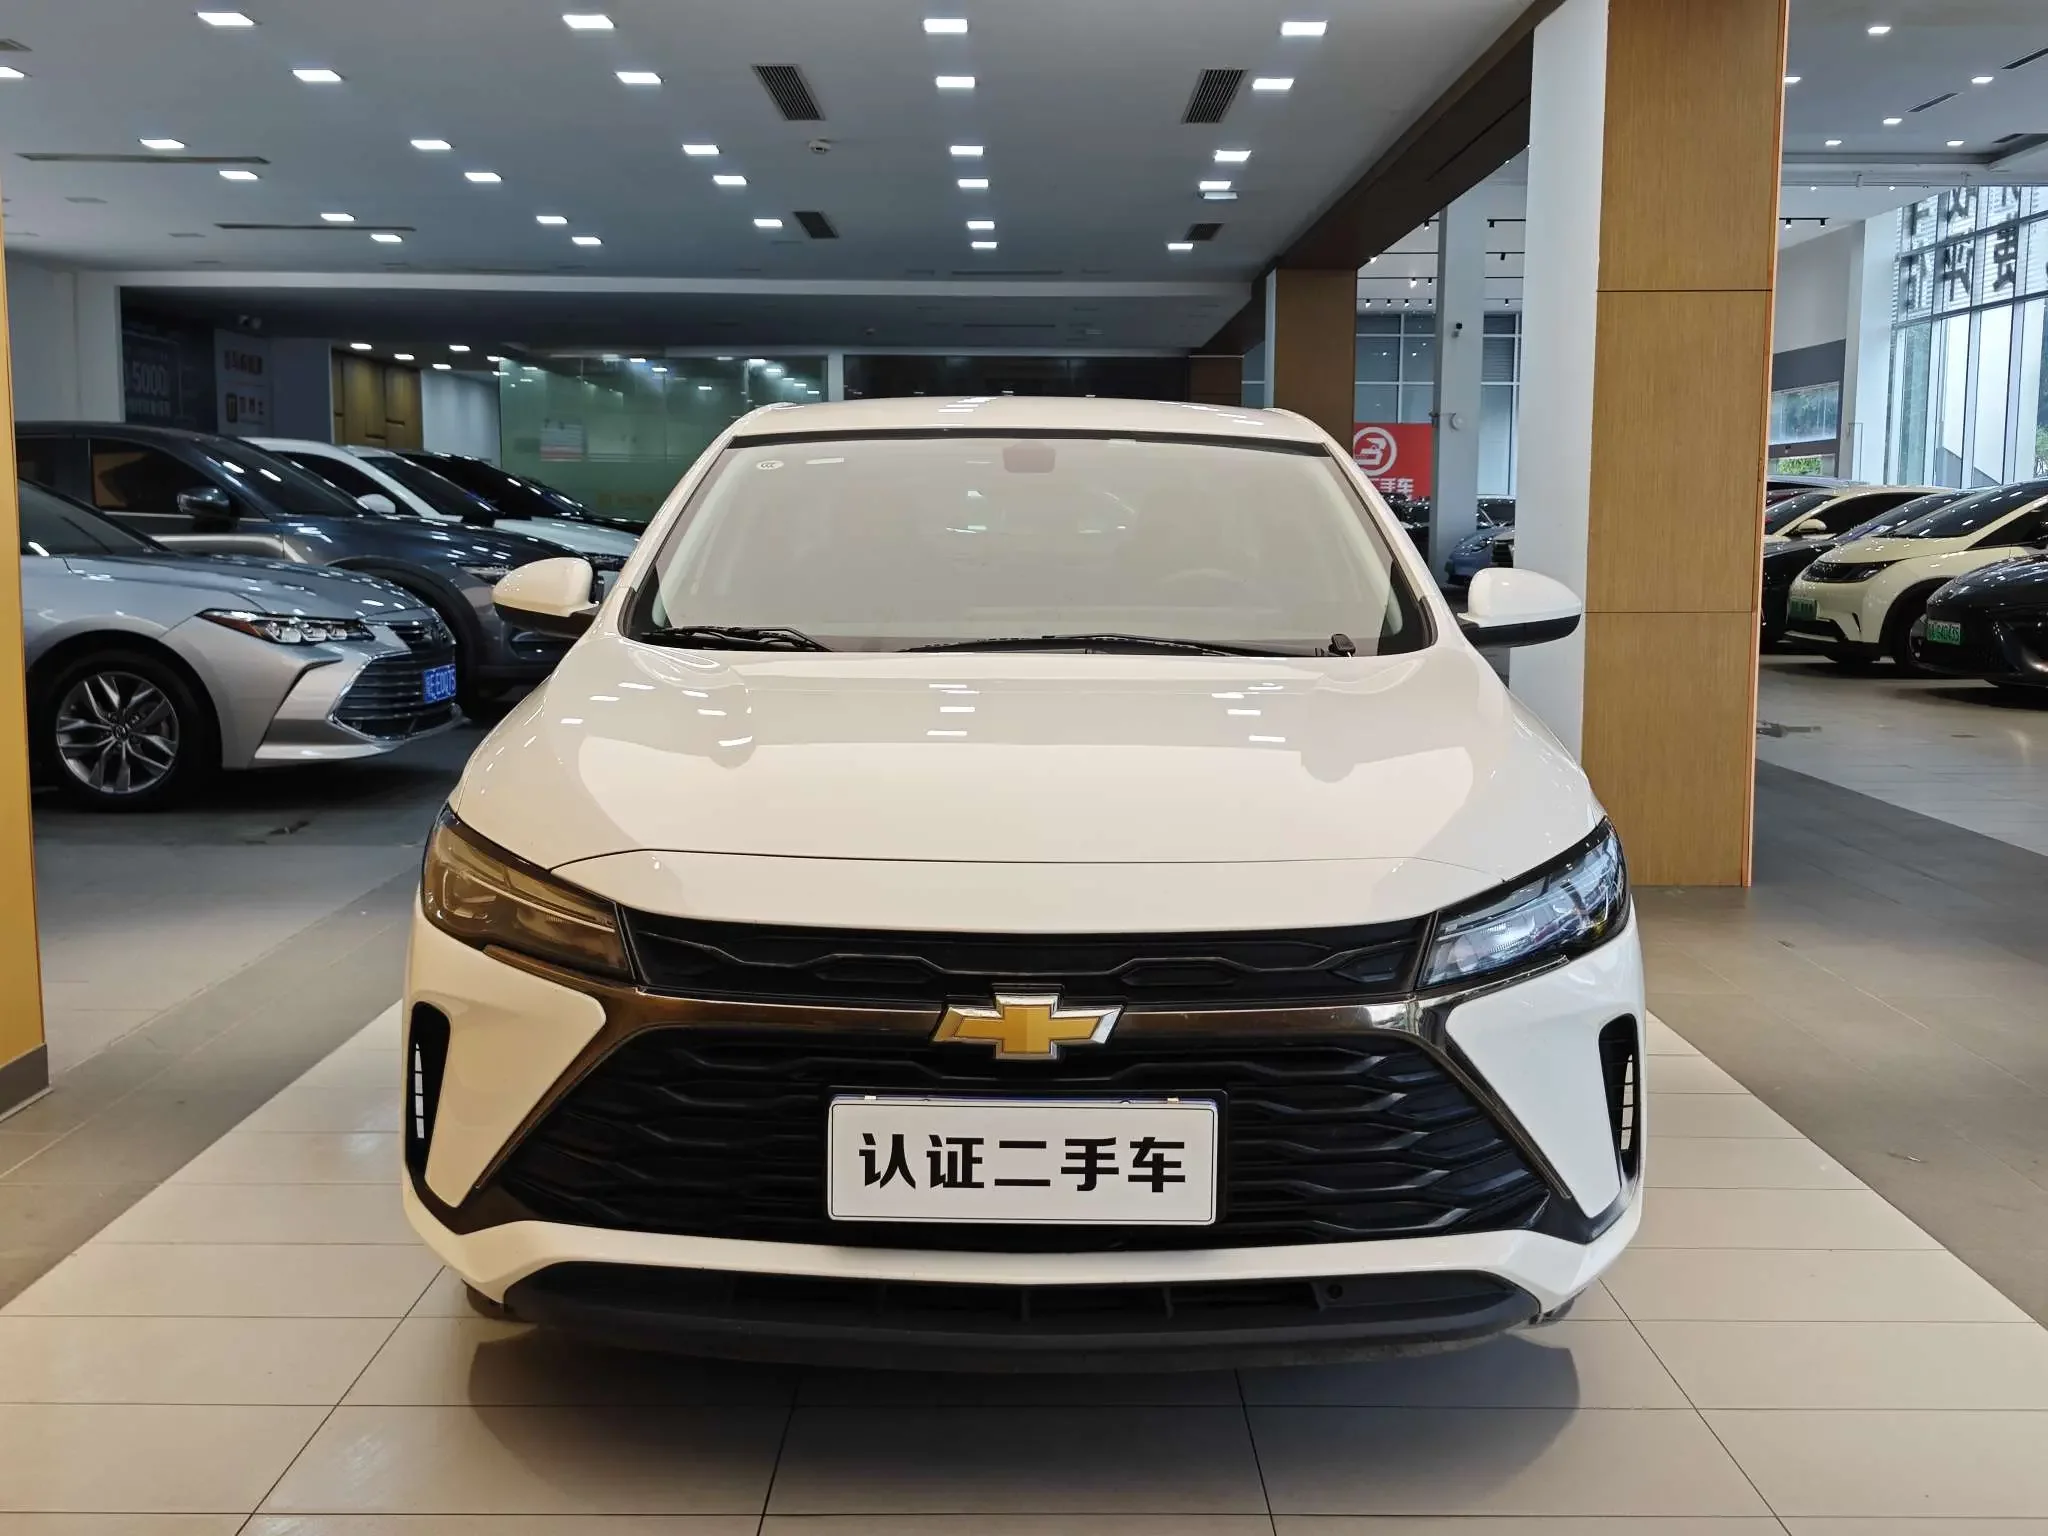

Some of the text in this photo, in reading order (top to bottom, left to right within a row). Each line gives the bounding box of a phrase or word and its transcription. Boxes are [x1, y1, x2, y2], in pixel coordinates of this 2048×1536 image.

[858, 1132, 1186, 1193] 认证二手车
